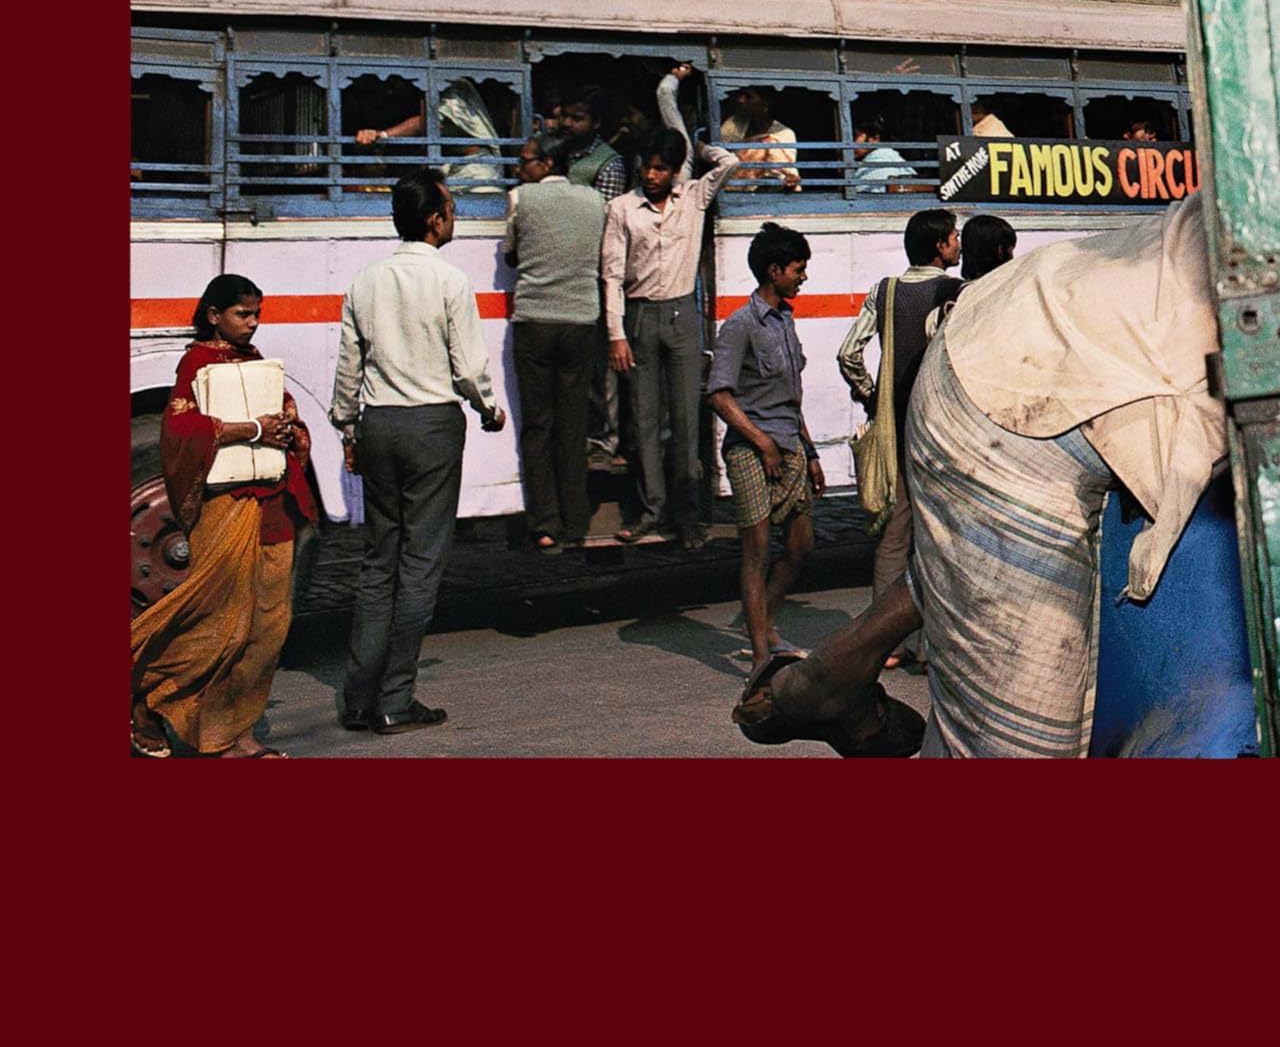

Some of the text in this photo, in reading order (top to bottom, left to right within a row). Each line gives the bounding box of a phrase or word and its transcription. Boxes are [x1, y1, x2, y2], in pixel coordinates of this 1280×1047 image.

[945, 142, 961, 162] AT
[986, 142, 1201, 200] FAMOUS CIRCU
